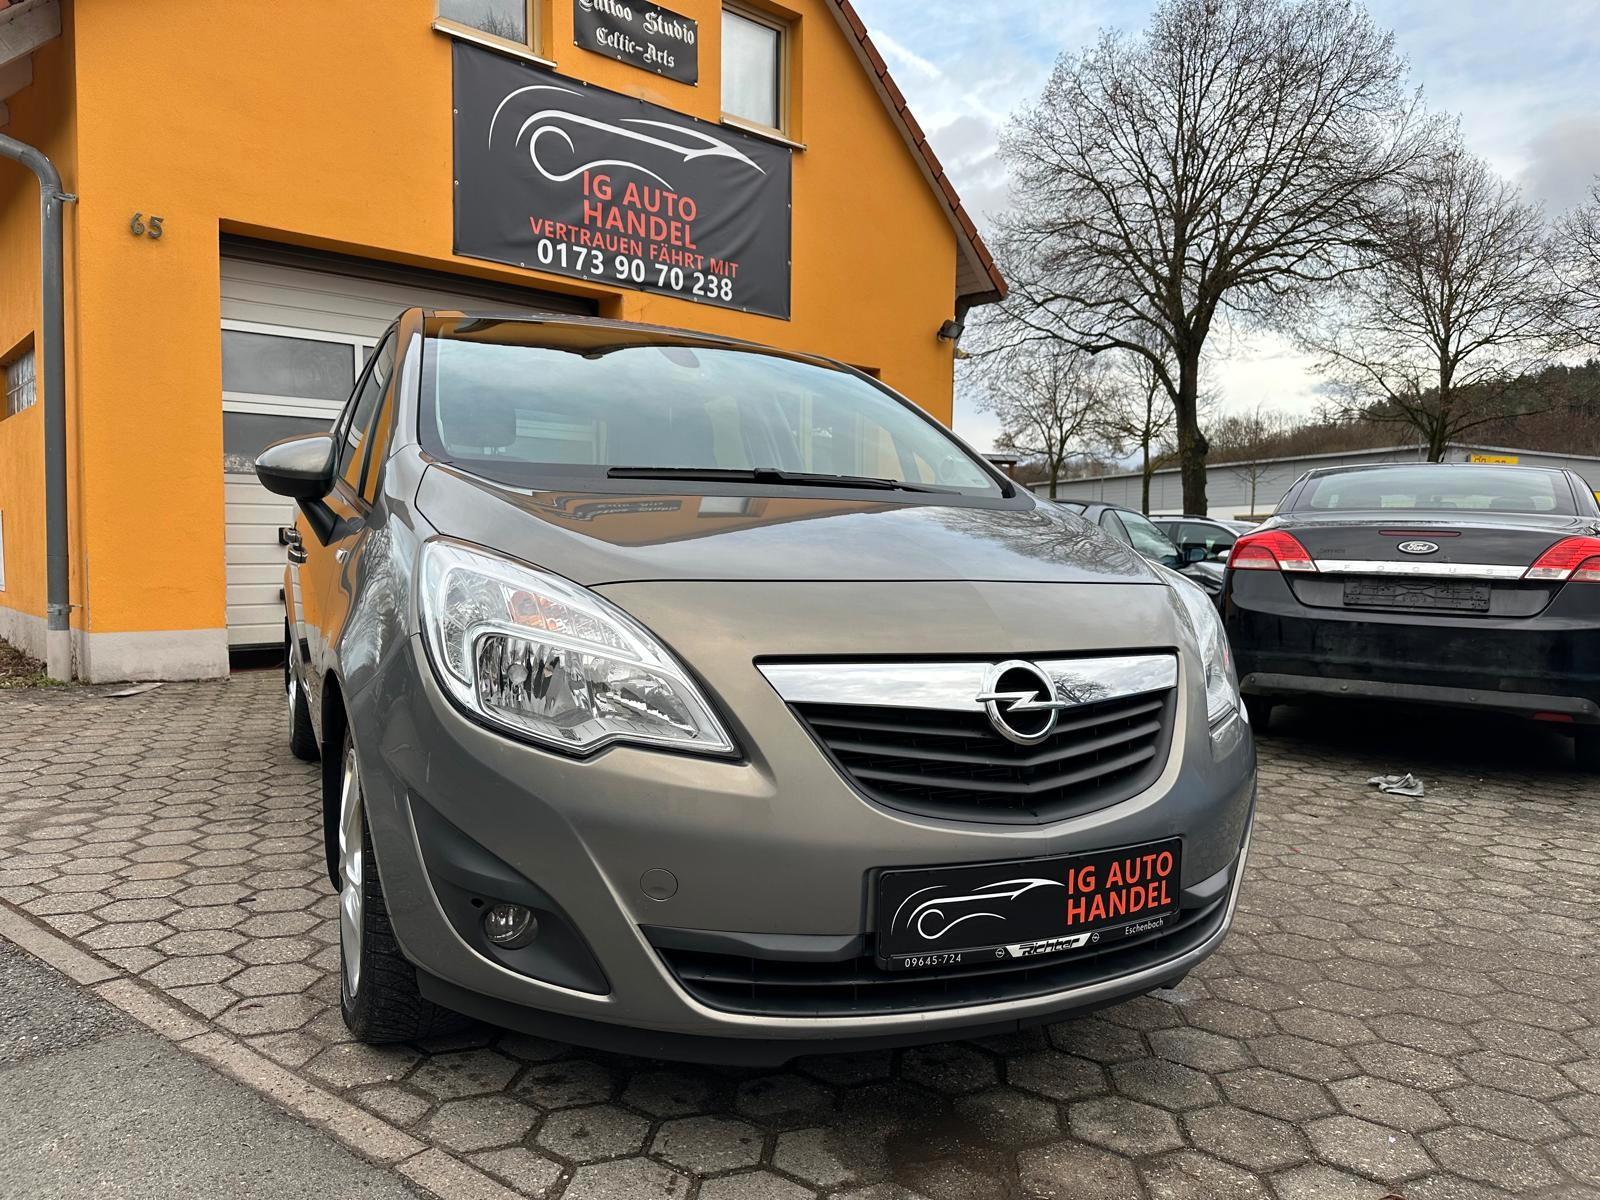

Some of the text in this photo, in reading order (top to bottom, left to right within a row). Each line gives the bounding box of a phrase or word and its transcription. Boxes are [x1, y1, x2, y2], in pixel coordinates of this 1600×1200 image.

[596, 27, 675, 68] Celtic-Arts
[643, 12, 695, 45] Studio
[583, 170, 697, 221] IG AUTO
[130, 212, 164, 239] 65
[529, 216, 739, 278] VERTRAUEN FÄHRT MIT
[583, 199, 697, 250] HANDEL
[537, 238, 733, 301] 0173 90 70 238
[1407, 542, 1429, 551] Ford
[1068, 850, 1173, 895] IG AUTO
[1067, 880, 1171, 925] HANDEL
[904, 918, 1164, 968] 09645-724 Richter Eschenbach
